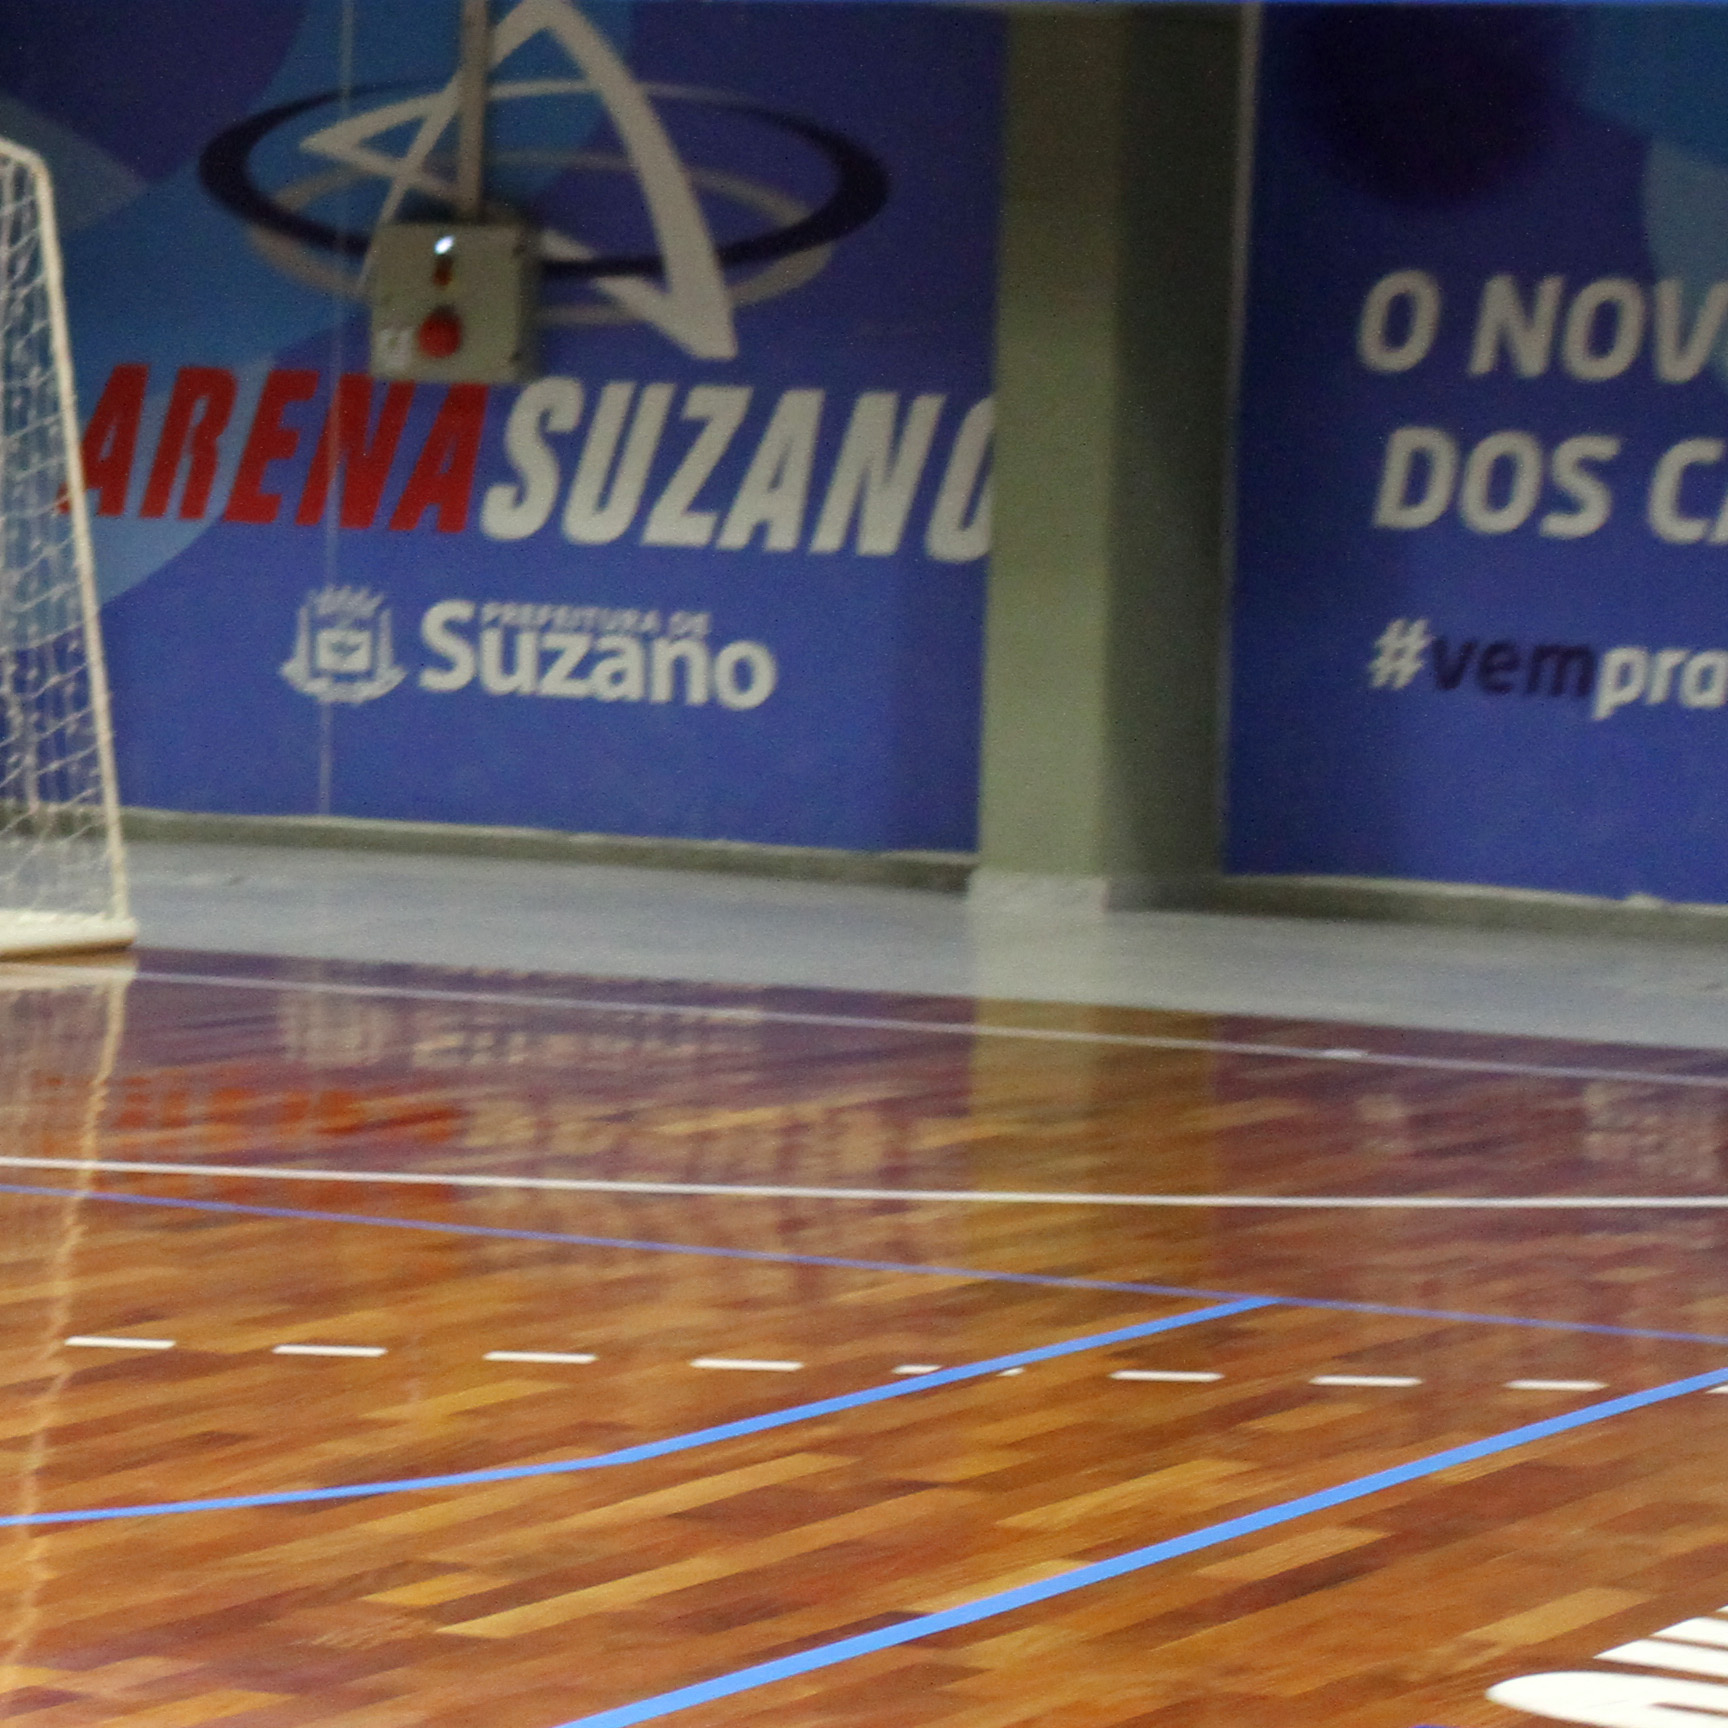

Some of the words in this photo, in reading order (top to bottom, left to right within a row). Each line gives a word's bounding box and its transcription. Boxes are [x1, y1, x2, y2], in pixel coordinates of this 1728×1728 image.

[1356, 269, 1441, 374] O
[1374, 425, 1621, 539] DOS
[1649, 437, 1728, 544] C
[419, 599, 777, 710] Suzano
